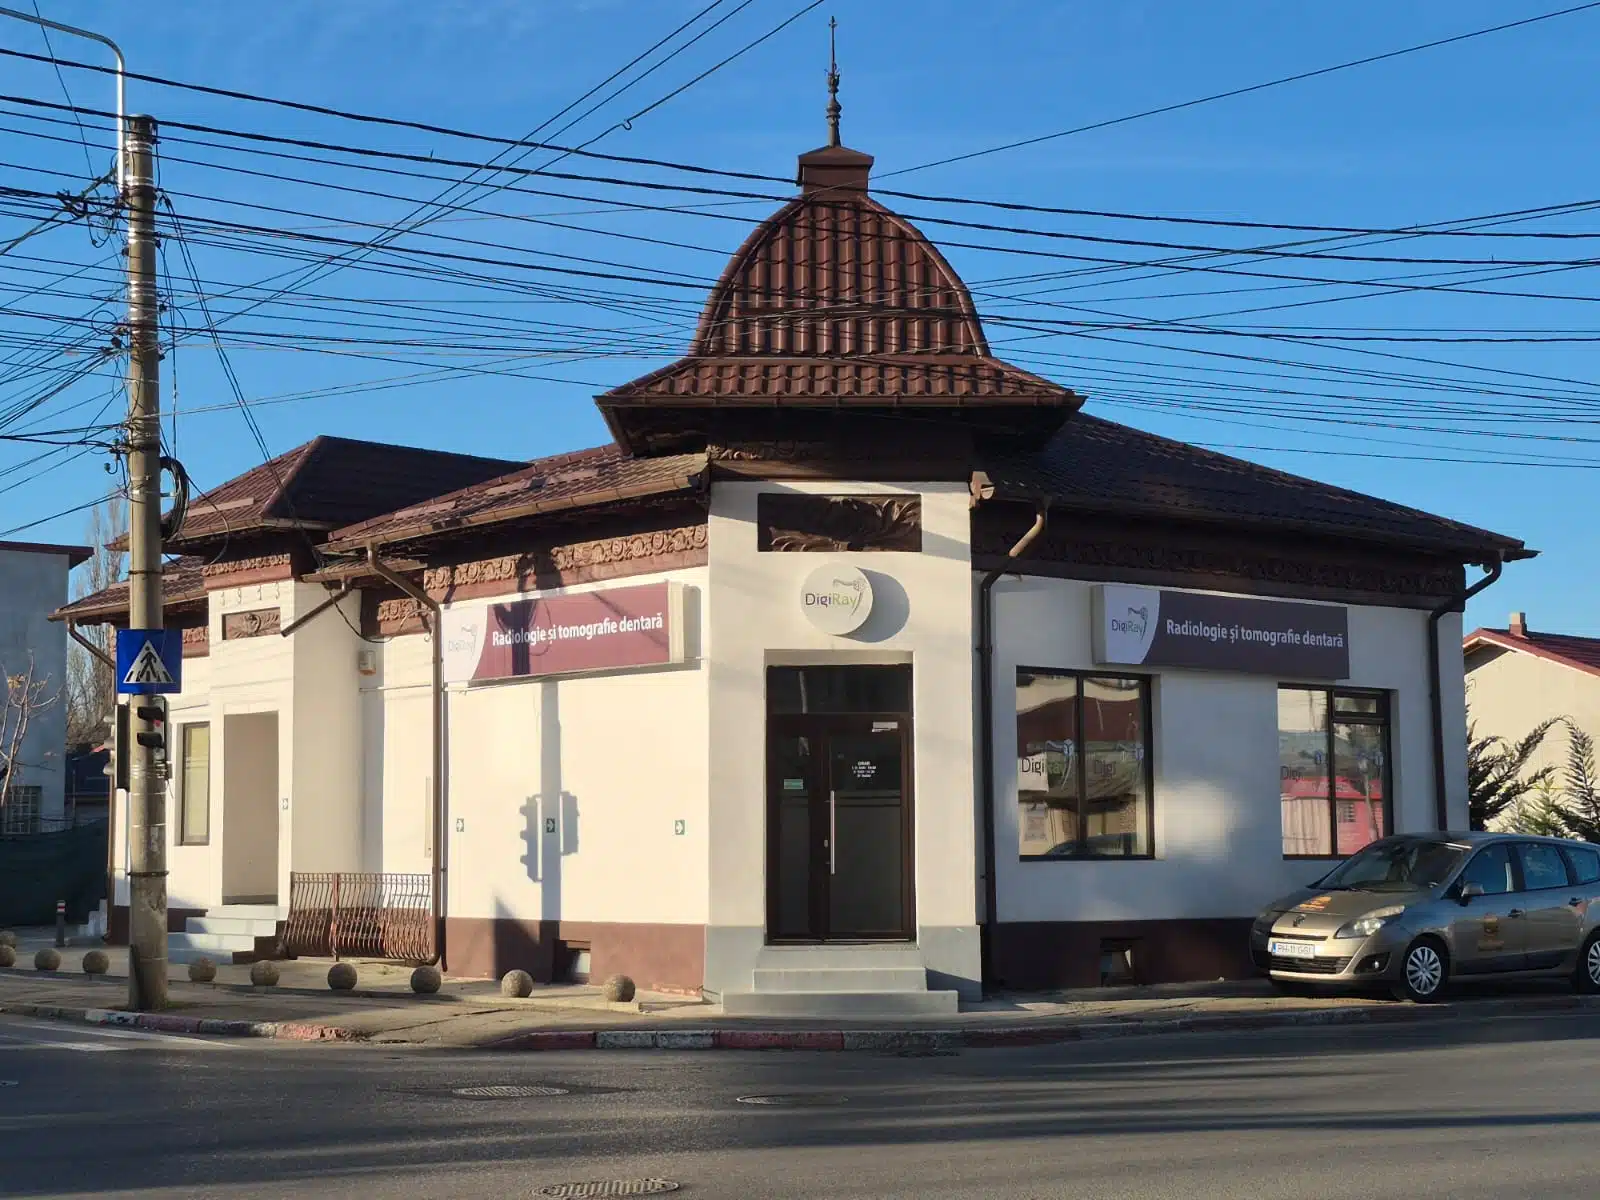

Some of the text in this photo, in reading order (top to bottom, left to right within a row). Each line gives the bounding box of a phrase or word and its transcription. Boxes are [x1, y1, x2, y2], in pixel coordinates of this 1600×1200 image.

[805, 592, 857, 609] DigiRay
[492, 626, 547, 647] Radiologie
[558, 617, 617, 642] tomografie
[619, 612, 663, 634] dentară
[1111, 618, 1143, 637] DigiRay
[1166, 619, 1227, 642] Radiologie
[1241, 626, 1301, 647] tomografie
[1302, 630, 1343, 648] dentară
